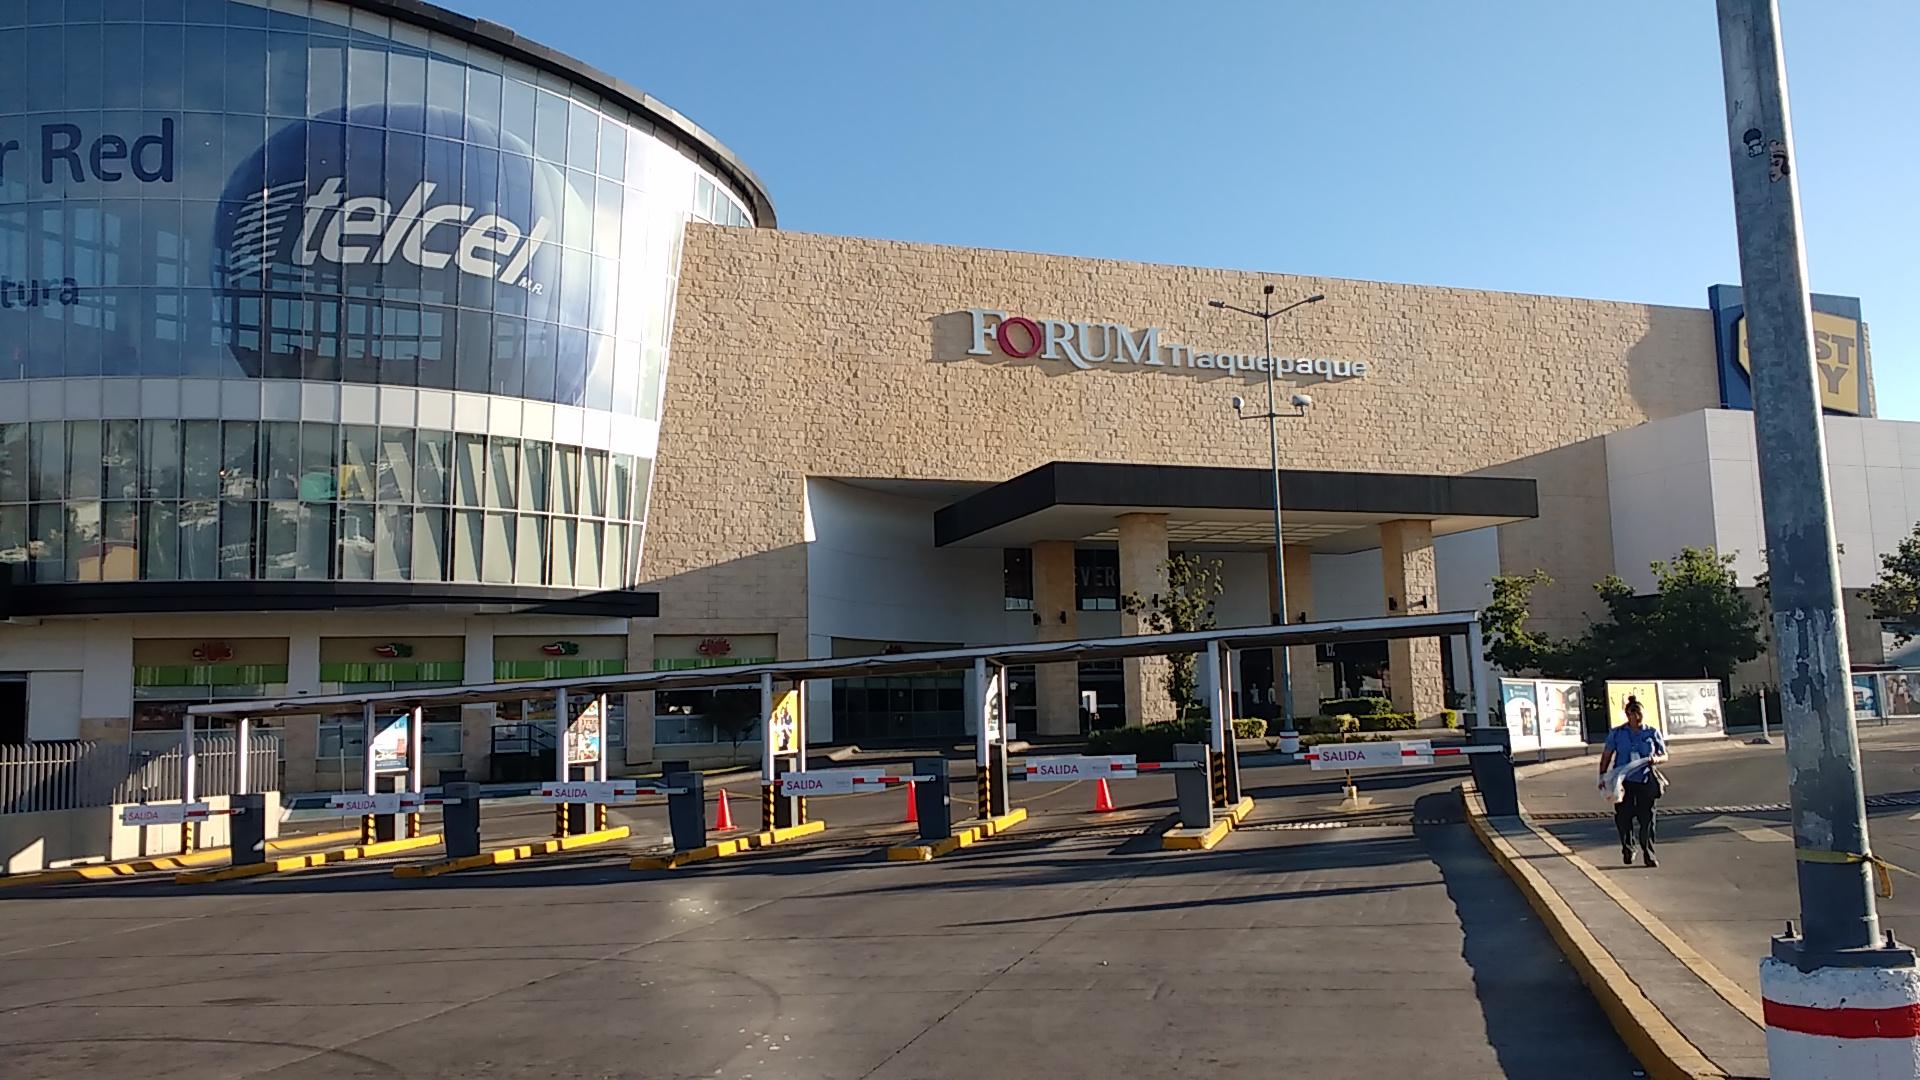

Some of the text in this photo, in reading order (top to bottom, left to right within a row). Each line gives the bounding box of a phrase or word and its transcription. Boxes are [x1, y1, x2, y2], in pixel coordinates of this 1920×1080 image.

[41, 117, 174, 184] Red
[292, 177, 548, 284] telcel
[967, 307, 1368, 381] FORUM Tlaquepaque
[1322, 750, 1366, 762] SALIDA
[1040, 764, 1079, 775] SALIDA
[786, 779, 823, 790] SALIDA
[554, 788, 588, 798] SALIDA
[346, 800, 377, 810] SALIDA
[128, 811, 159, 821] SALIDA
